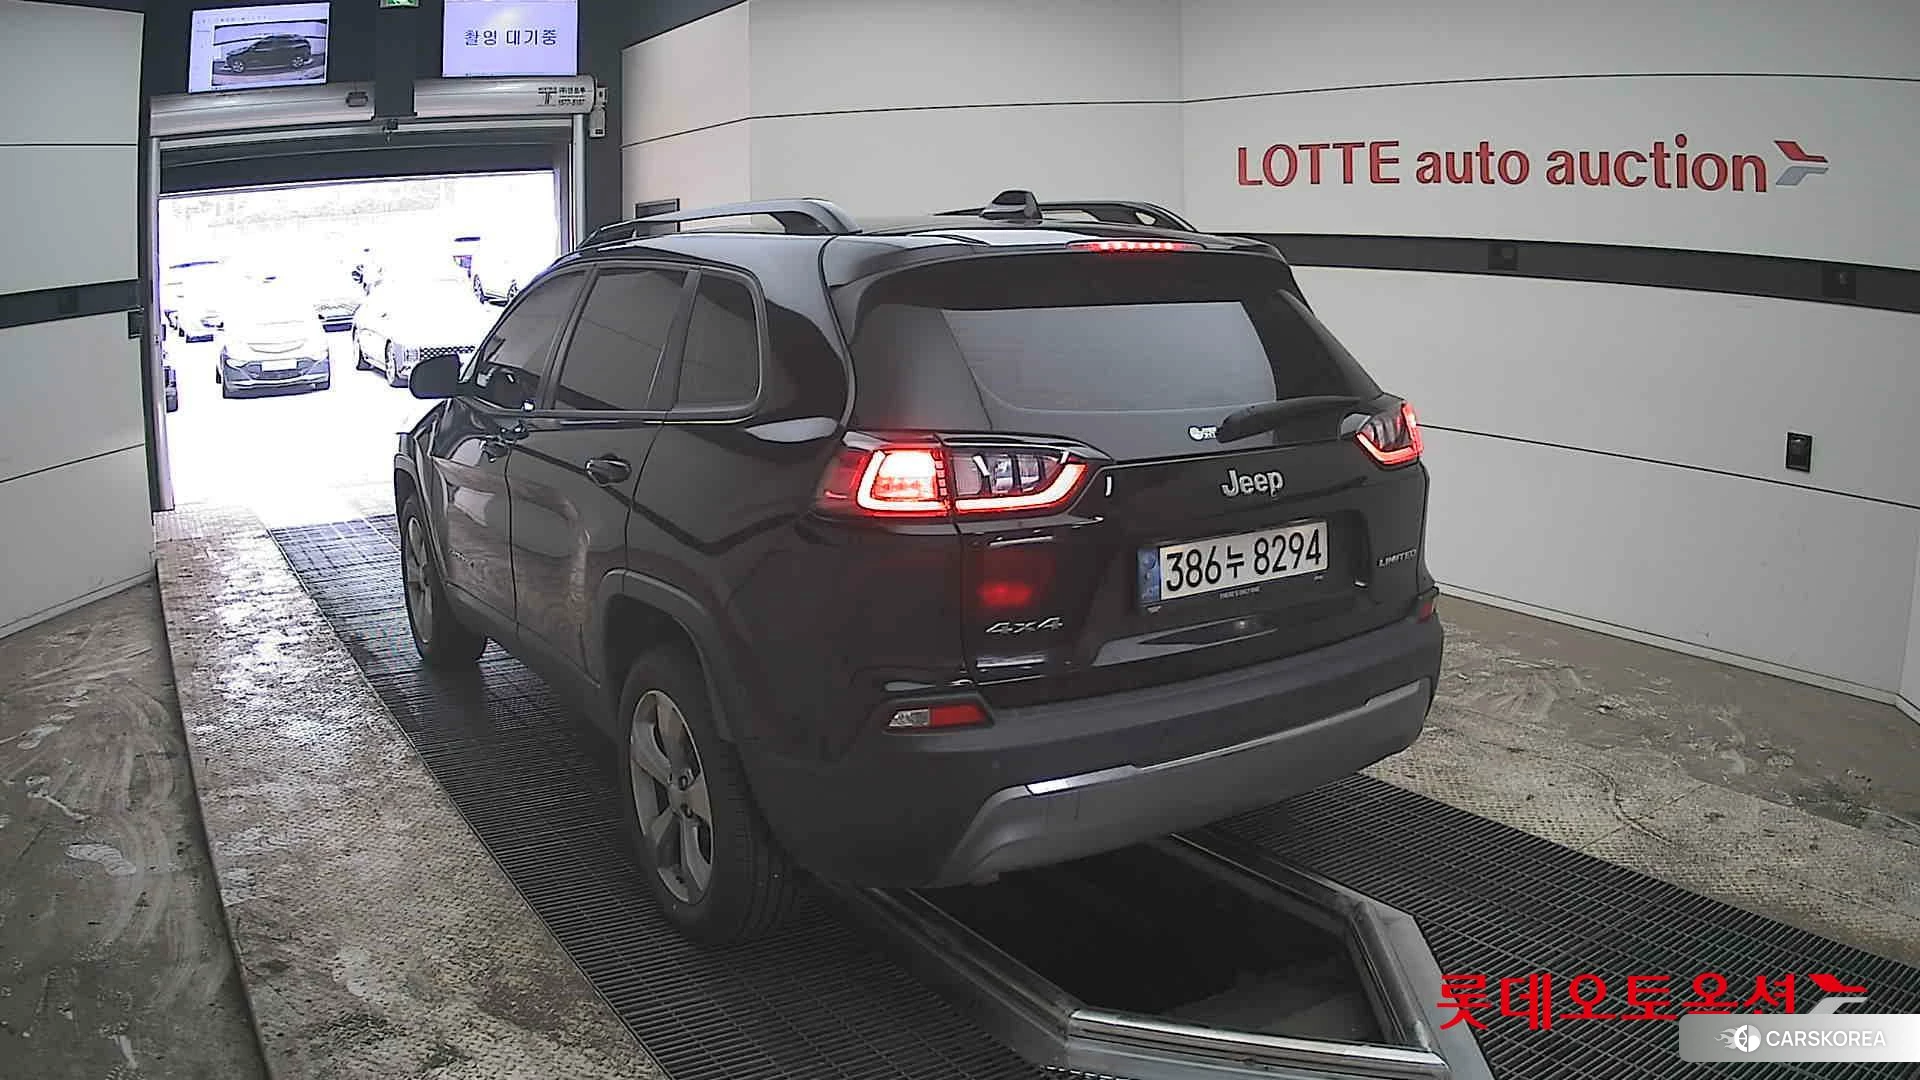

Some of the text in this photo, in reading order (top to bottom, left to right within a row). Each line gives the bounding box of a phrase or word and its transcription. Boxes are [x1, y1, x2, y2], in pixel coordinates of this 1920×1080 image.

[506, 29, 557, 46] 대기중
[1237, 134, 1767, 193] LOTTE auto auction
[1221, 469, 1284, 497] Jeep
[1166, 528, 1322, 592] 386누 8294
